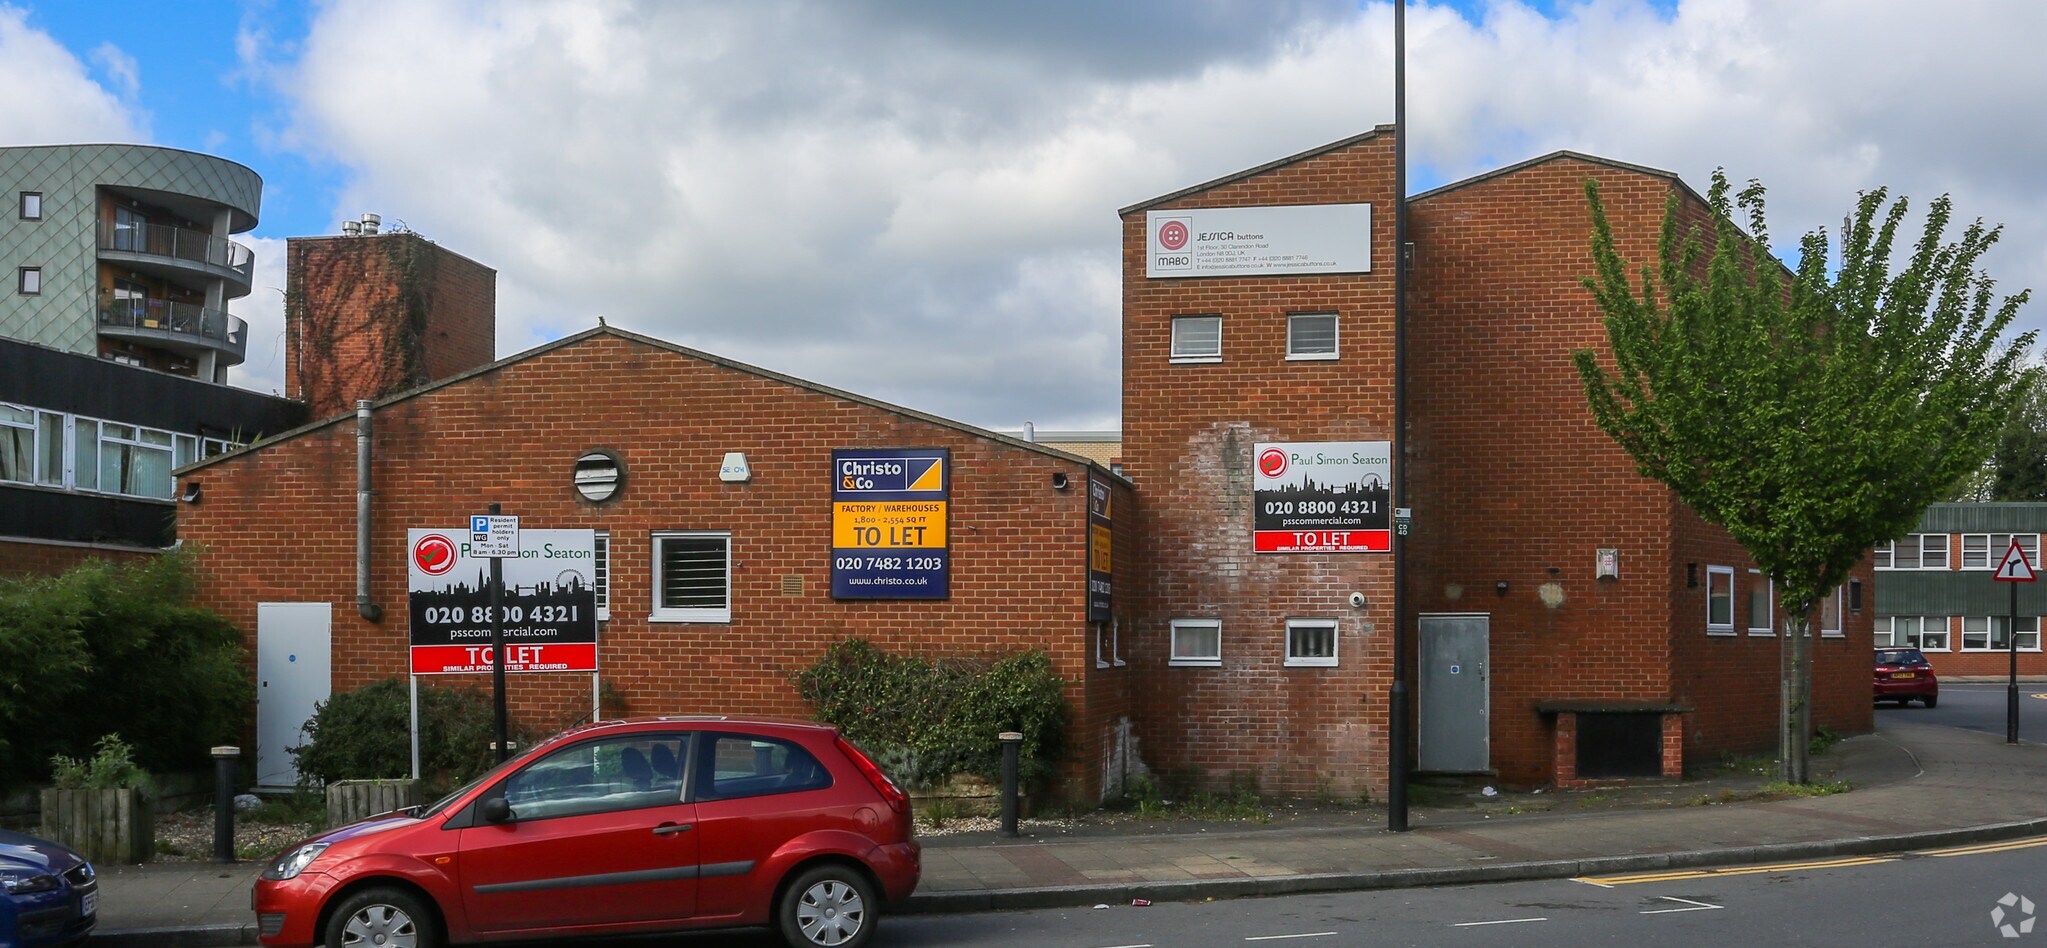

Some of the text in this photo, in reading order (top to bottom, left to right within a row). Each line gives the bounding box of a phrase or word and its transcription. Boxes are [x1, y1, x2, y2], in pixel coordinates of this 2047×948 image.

[1197, 232, 1233, 241] JESSICA
[1158, 257, 1189, 266] MABO
[1291, 452, 1388, 466] Paul Simon Seaton
[842, 461, 902, 476] Christo
[842, 475, 874, 489] &Co
[841, 504, 876, 513] FACTORY
[884, 504, 939, 513] WAREHOUSES
[1265, 500, 1377, 515] 020 8800 4321
[476, 518, 486, 531] P
[854, 517, 876, 525] 1,800
[883, 517, 904, 525] 2,554
[906, 516, 917, 524] SQ
[1282, 516, 1362, 527] psscommercial.com
[853, 526, 927, 546] TO LET
[1293, 532, 1350, 546] TO LET
[544, 543, 591, 559] Seaton
[836, 557, 942, 570] 020 7482 1203
[849, 576, 928, 586] www.christo.co.uk
[425, 606, 465, 624] 020
[529, 605, 578, 623] 4321
[450, 626, 558, 640] psscomercial.com
[506, 646, 544, 664] LET
